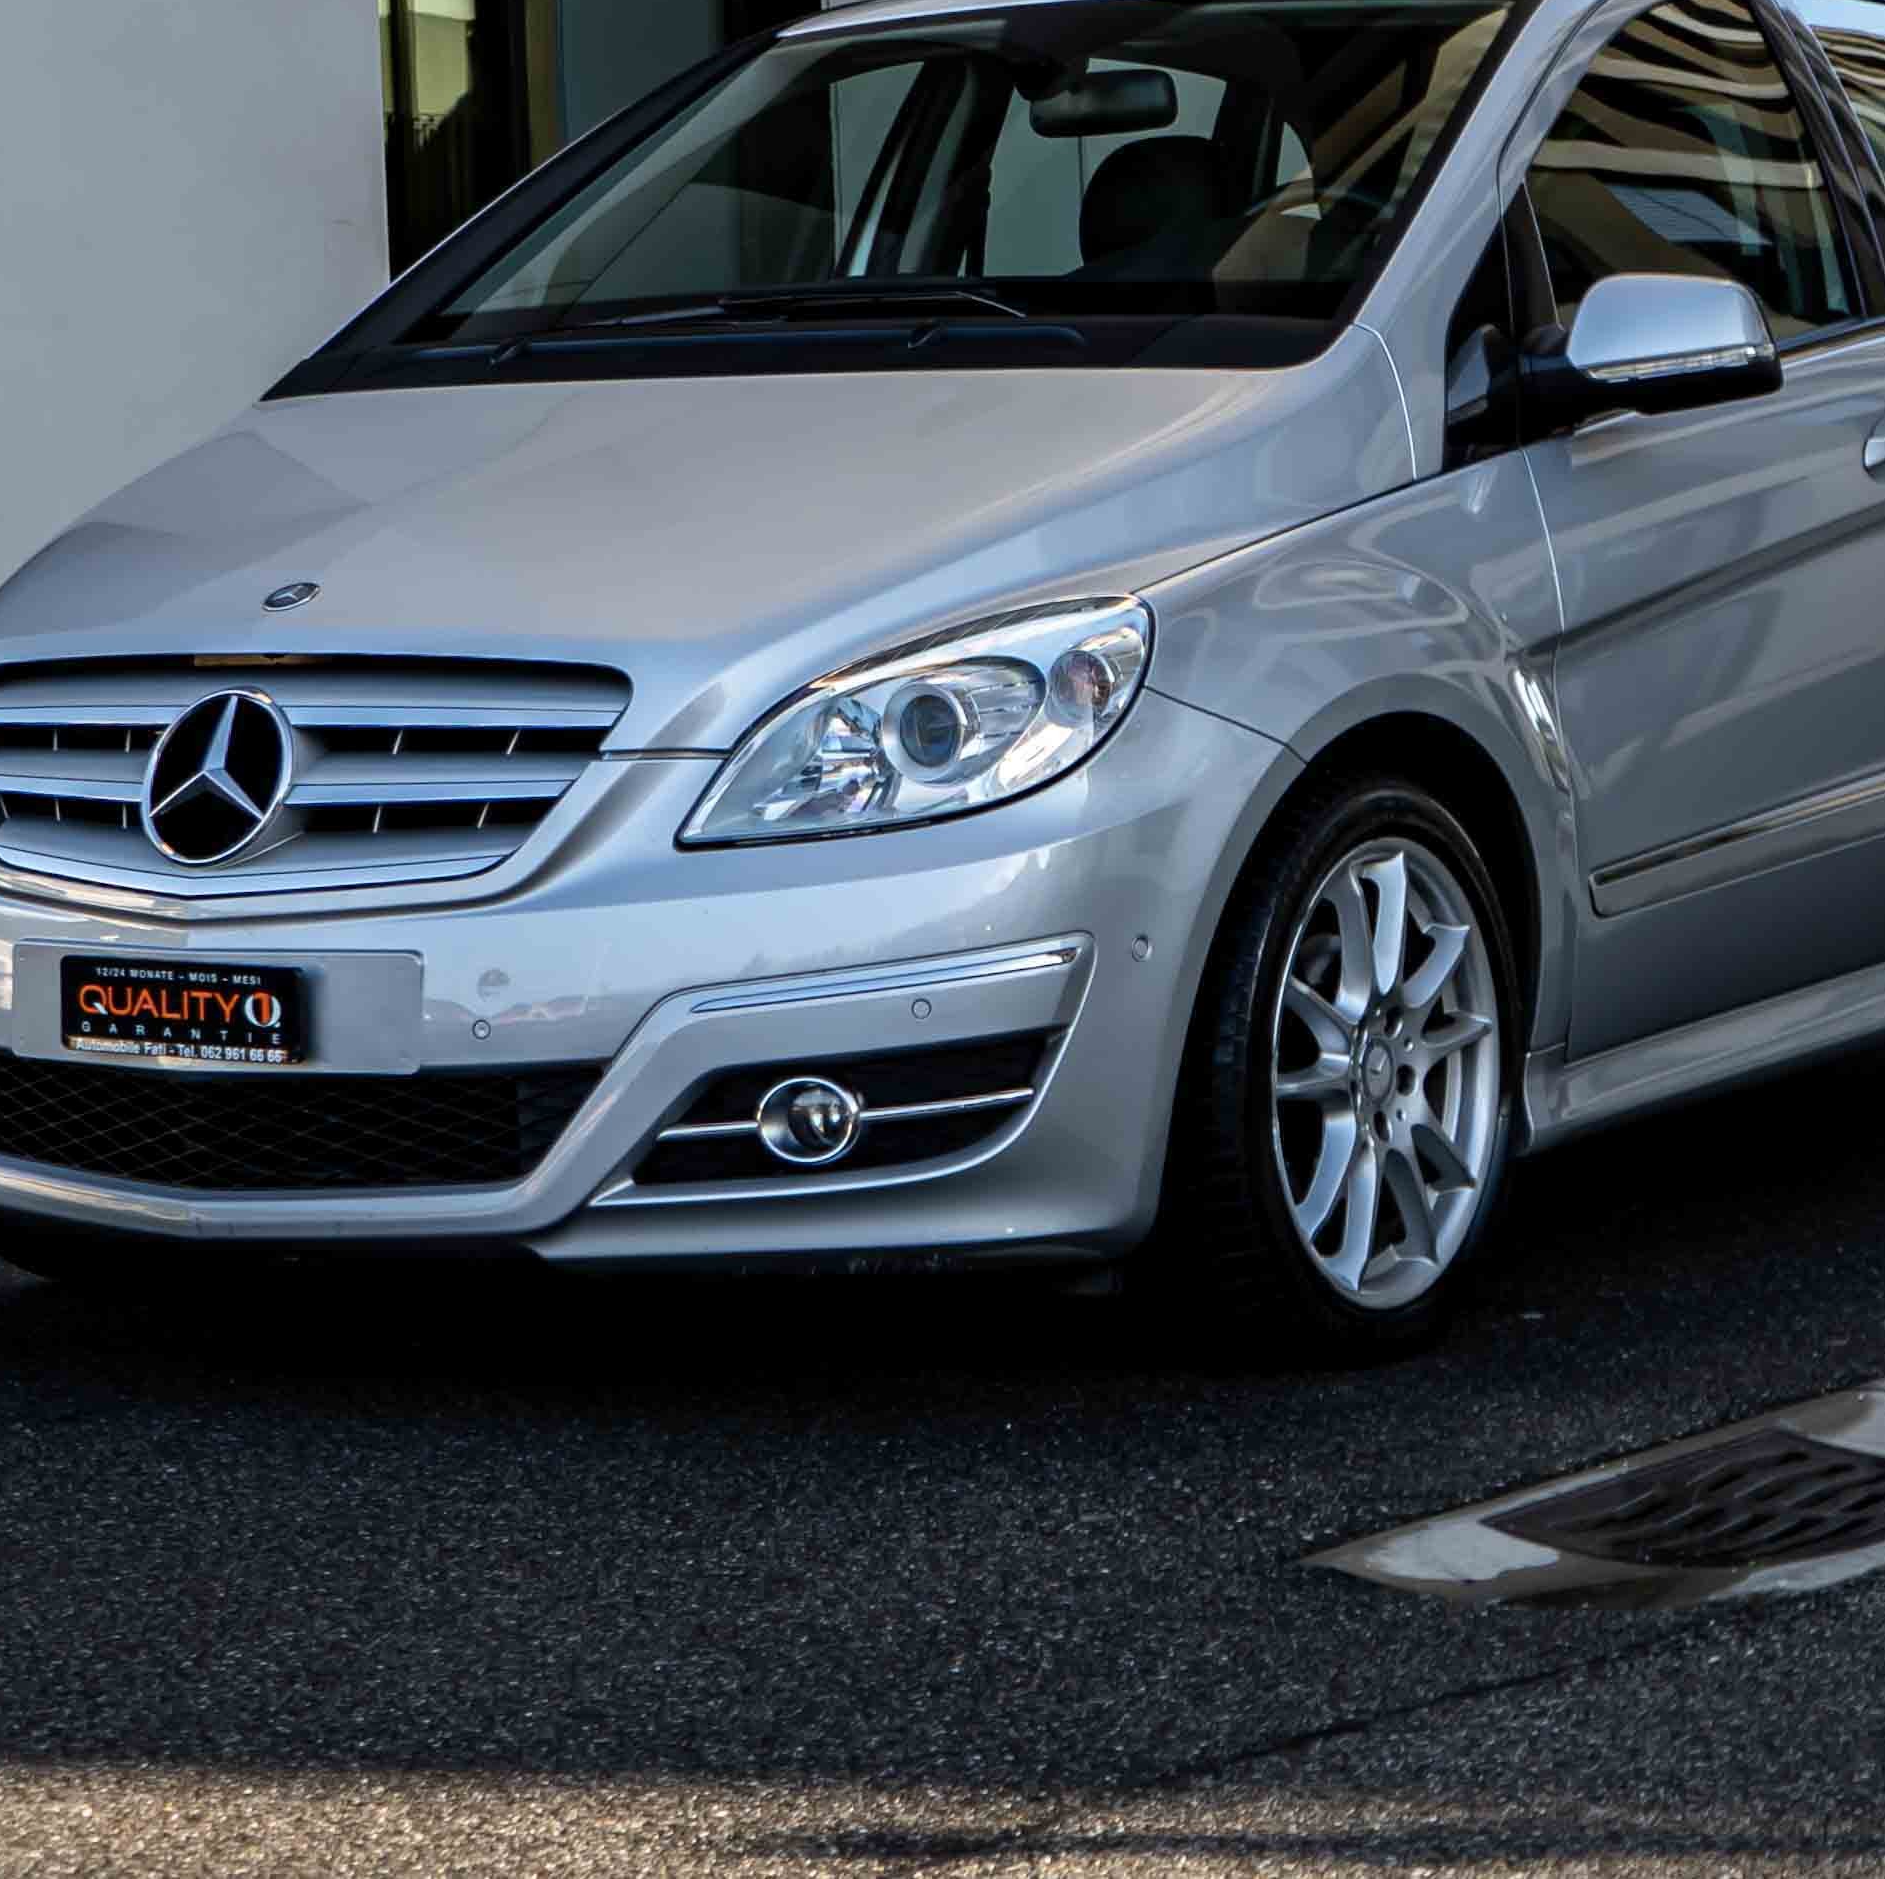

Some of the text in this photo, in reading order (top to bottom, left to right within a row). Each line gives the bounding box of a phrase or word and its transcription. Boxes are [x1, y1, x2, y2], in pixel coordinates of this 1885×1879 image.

[129, 969, 174, 981] MONATE
[189, 971, 218, 983] MOIS
[78, 984, 240, 1023] QUALITY
[81, 1020, 282, 1045] GARANTIE
[75, 1038, 141, 1054] Automobile
